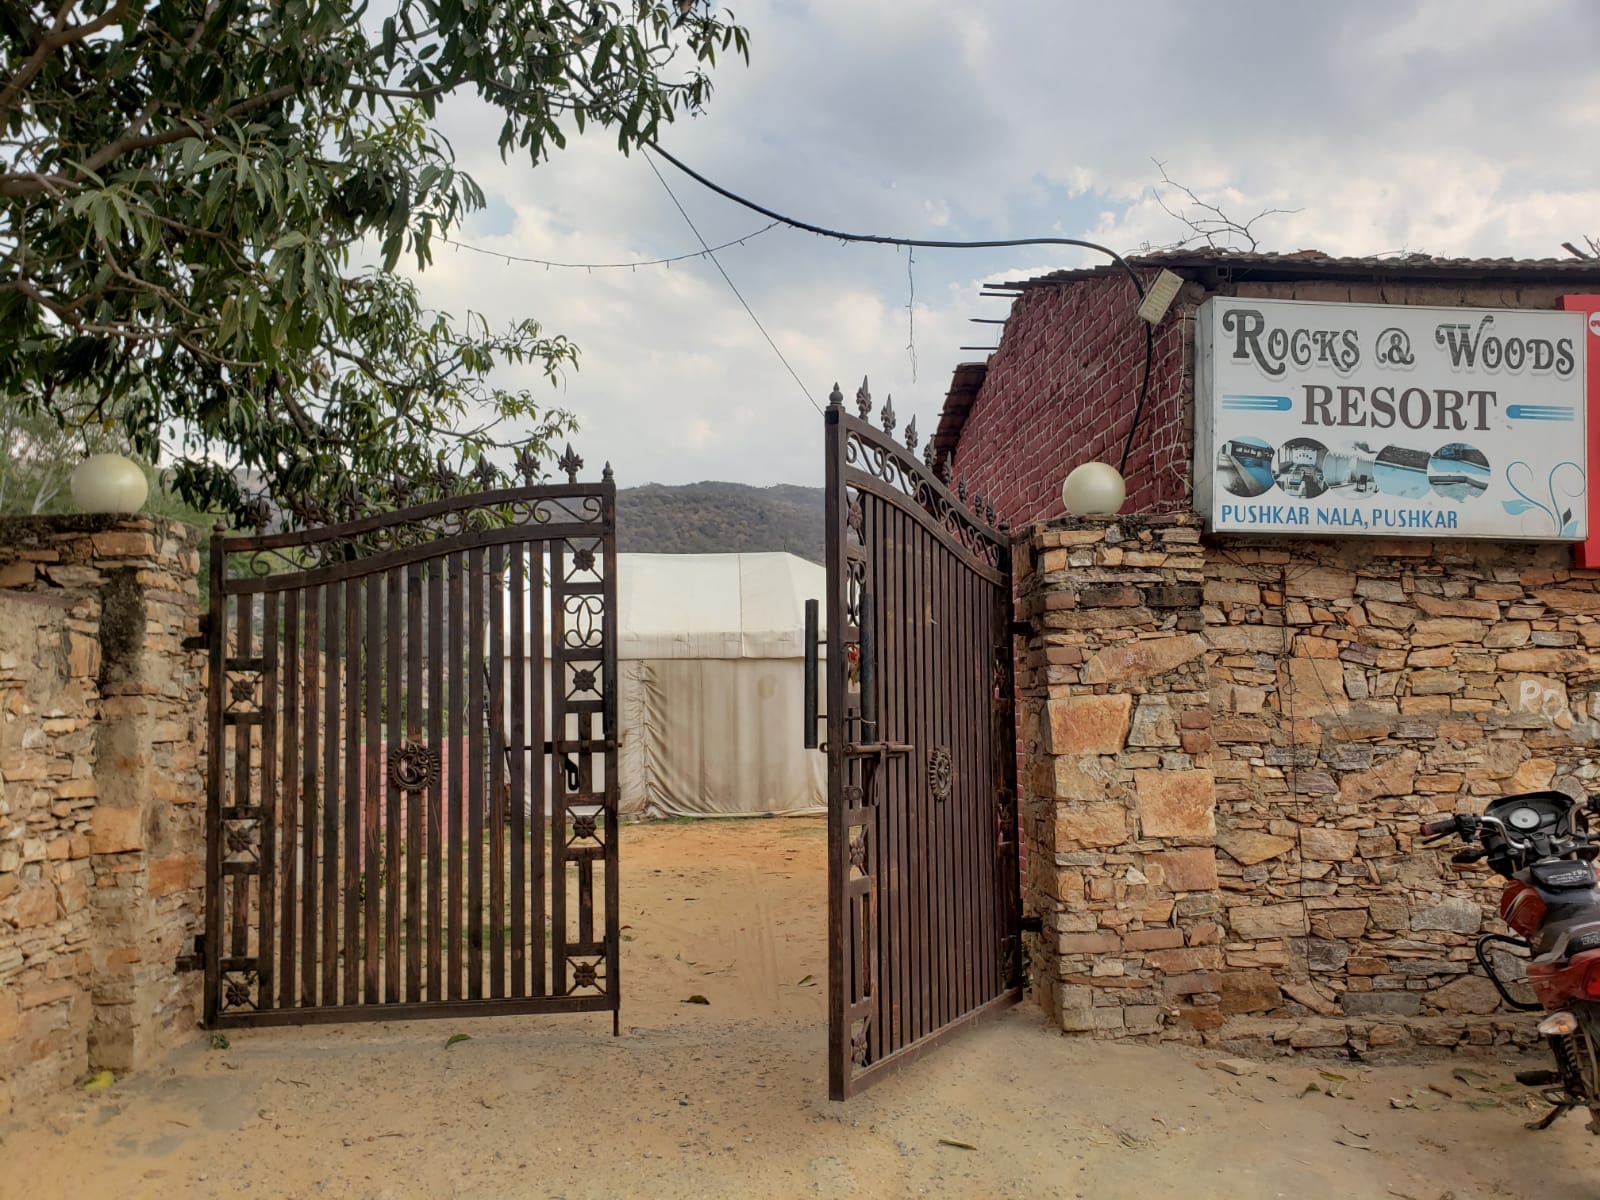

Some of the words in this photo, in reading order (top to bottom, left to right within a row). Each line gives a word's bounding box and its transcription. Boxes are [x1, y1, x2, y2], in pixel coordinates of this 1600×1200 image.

[1222, 309, 1360, 376] ROCKS
[1375, 327, 1415, 365] &
[1435, 315, 1575, 375] WOODS
[1301, 384, 1497, 431] RESORT
[1221, 505, 1309, 525] PUSHKAR
[1317, 507, 1369, 529] NALA,
[1372, 508, 1458, 529] PUSHKAR
